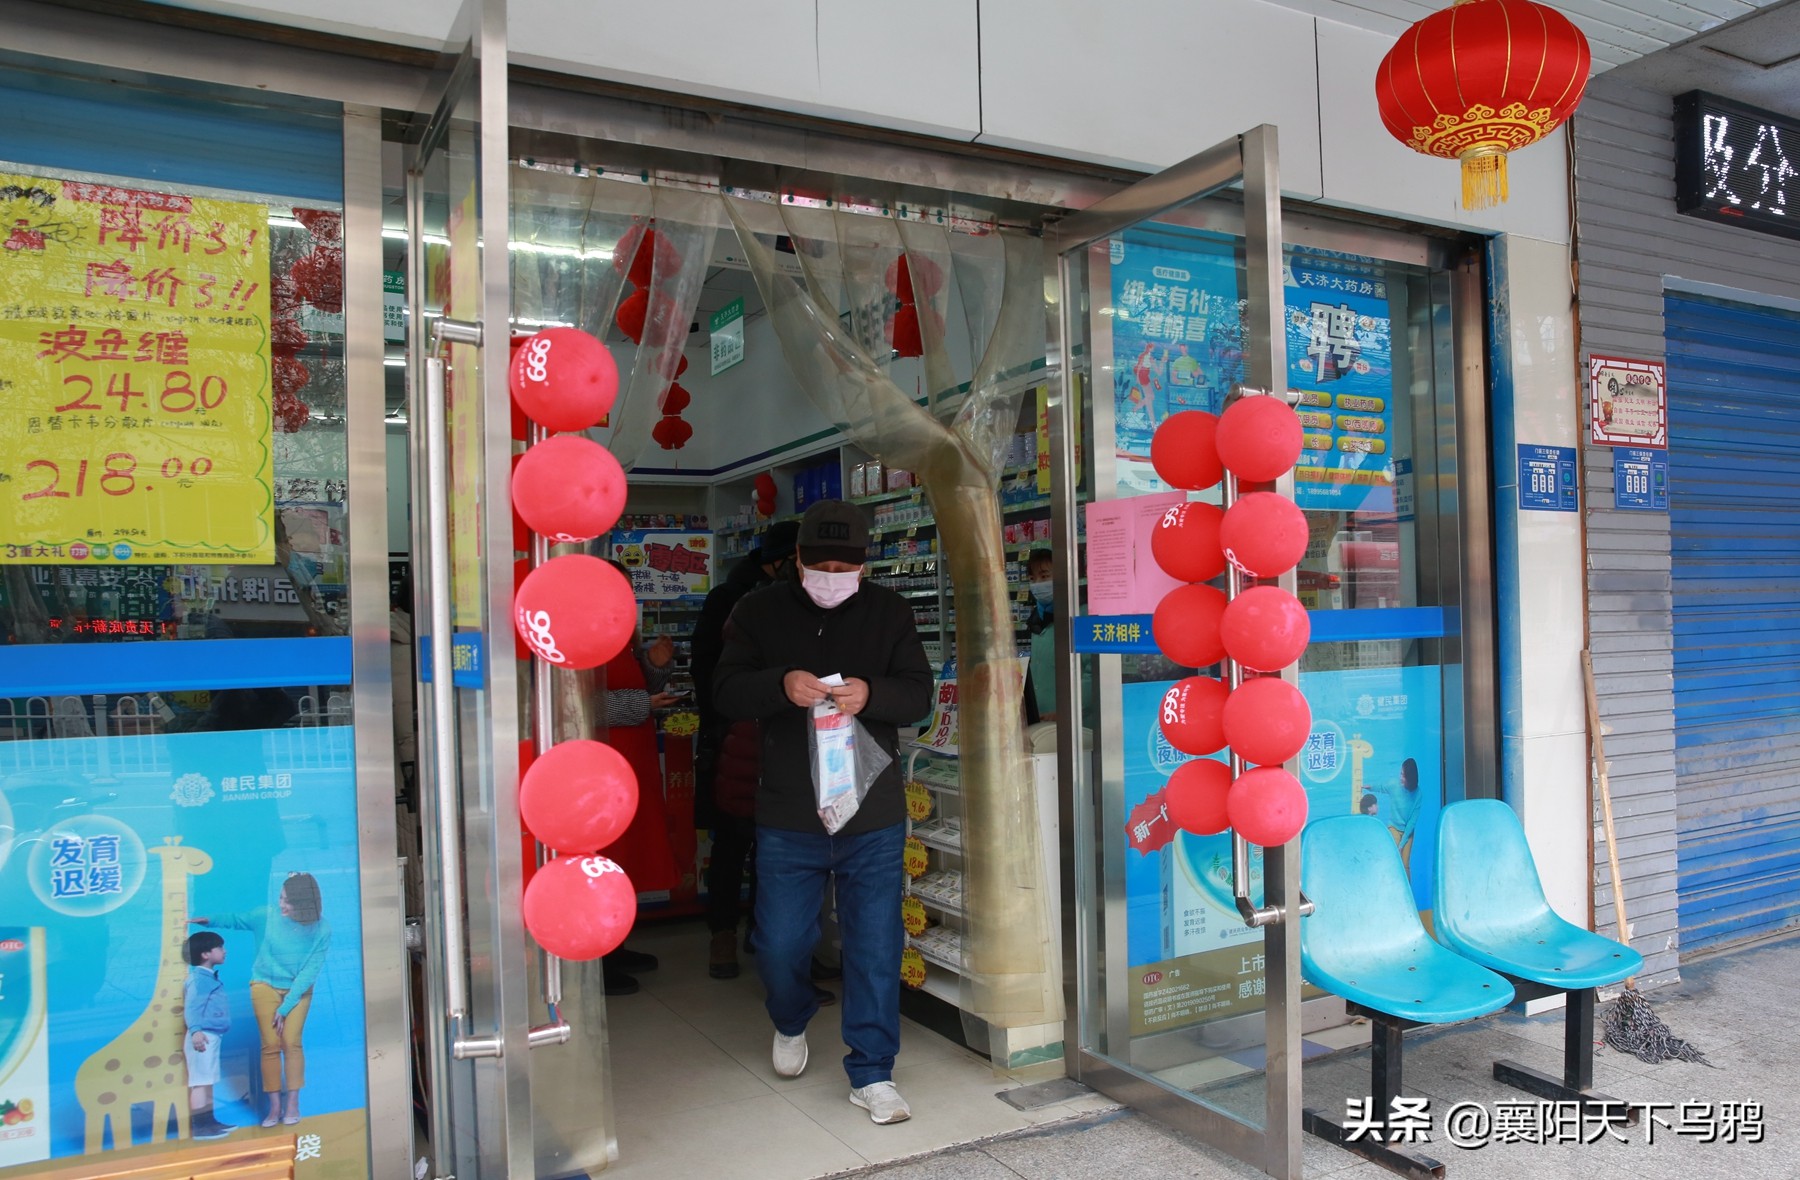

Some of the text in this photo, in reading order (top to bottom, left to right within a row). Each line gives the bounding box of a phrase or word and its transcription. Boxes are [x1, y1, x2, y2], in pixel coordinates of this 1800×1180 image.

[1300, 272, 1374, 295] 天济大药房
[1307, 302, 1358, 382] 聘
[526, 338, 552, 382] 999
[6, 543, 65, 559] 3重大礼
[526, 610, 566, 663] 999
[1163, 687, 1179, 725] 999
[1308, 731, 1336, 751] 发育
[1308, 753, 1336, 771] 迟缓
[221, 773, 292, 792] 健民集团
[52, 834, 120, 866] 发育
[52, 867, 121, 898] 迟缓
[1144, 973, 1160, 984] OTC
